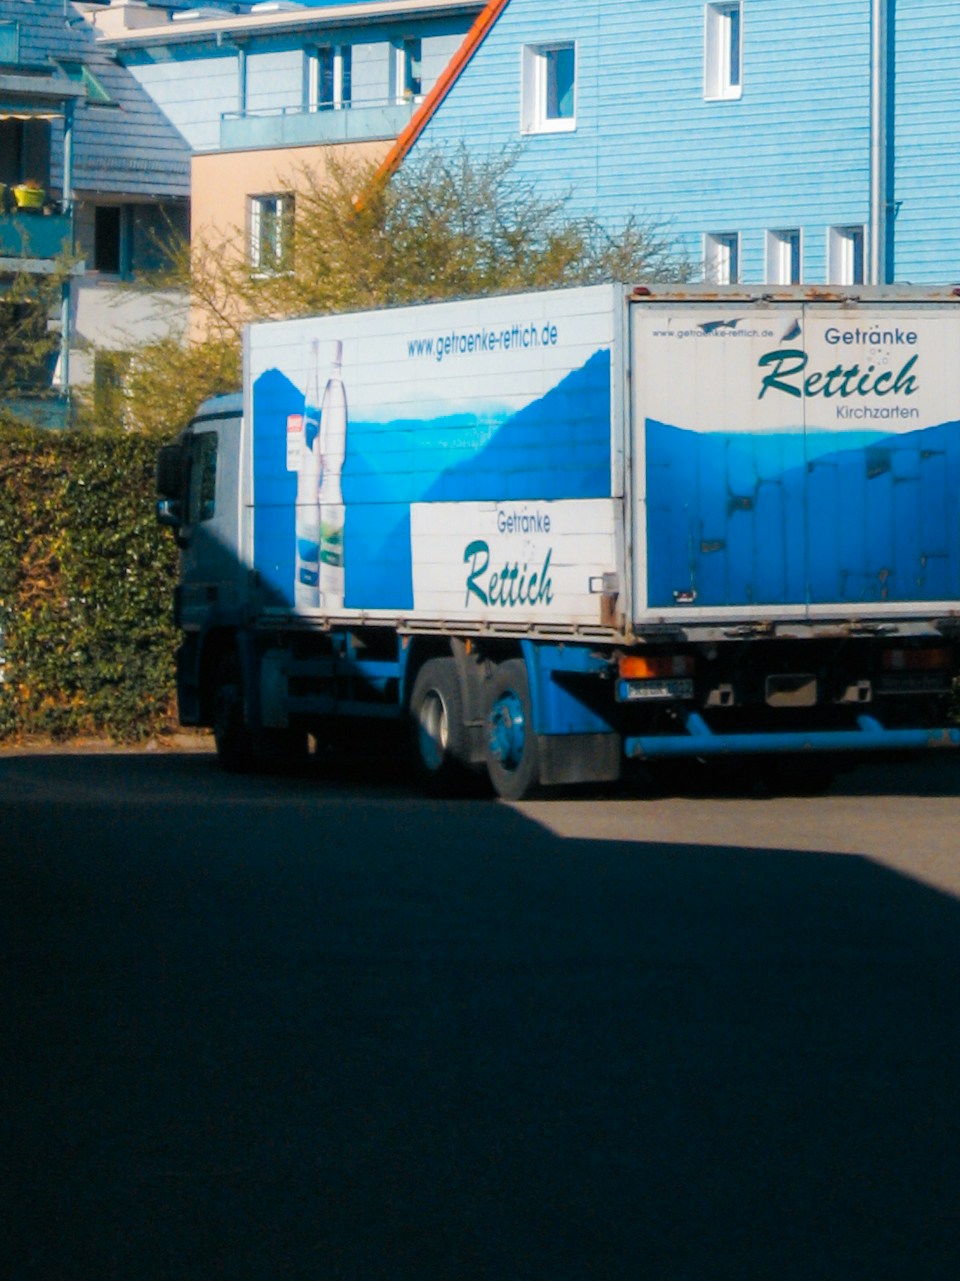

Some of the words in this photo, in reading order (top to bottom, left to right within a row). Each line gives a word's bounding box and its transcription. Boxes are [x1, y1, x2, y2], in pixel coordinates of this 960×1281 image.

[408, 321, 558, 362] www.getraenke-rettich.de
[824, 324, 918, 345] Getränke
[757, 349, 919, 400] Rettich
[836, 405, 919, 419] Kirchzarten
[497, 506, 551, 533] Getränke
[463, 539, 554, 608] Rettich
